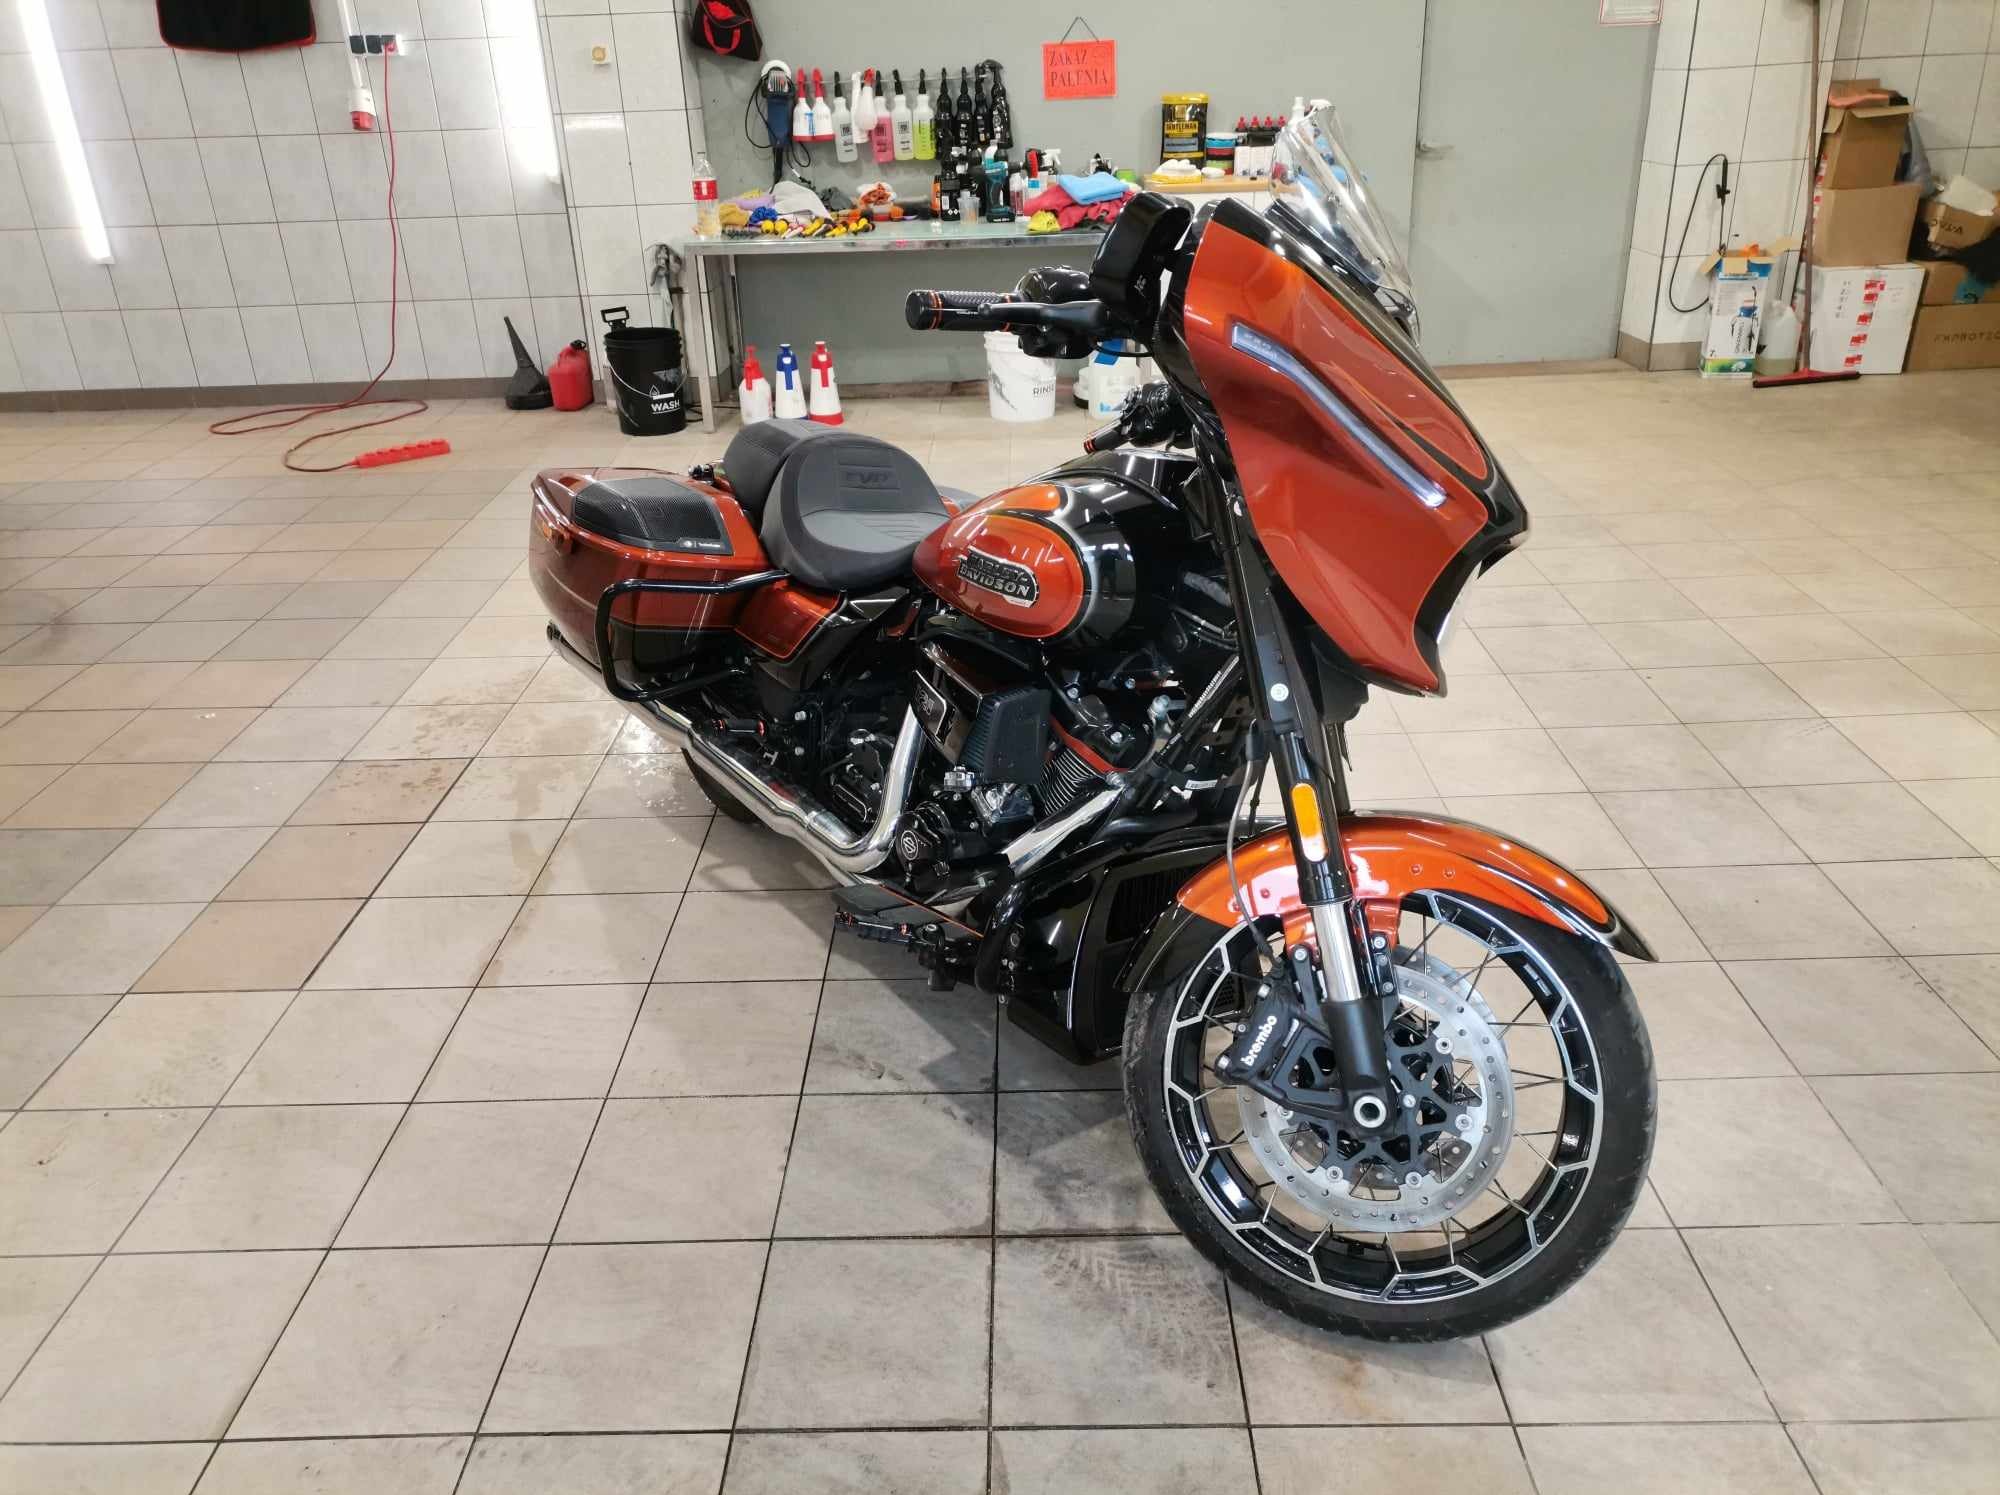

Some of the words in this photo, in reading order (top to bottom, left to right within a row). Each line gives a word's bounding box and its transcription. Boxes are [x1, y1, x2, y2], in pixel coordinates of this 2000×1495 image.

[1049, 48, 1088, 66] ZAKAZ
[650, 399, 681, 412] WASH
[959, 563, 1031, 597] DAVIDSON
[1240, 1015, 1278, 1067] brembo
